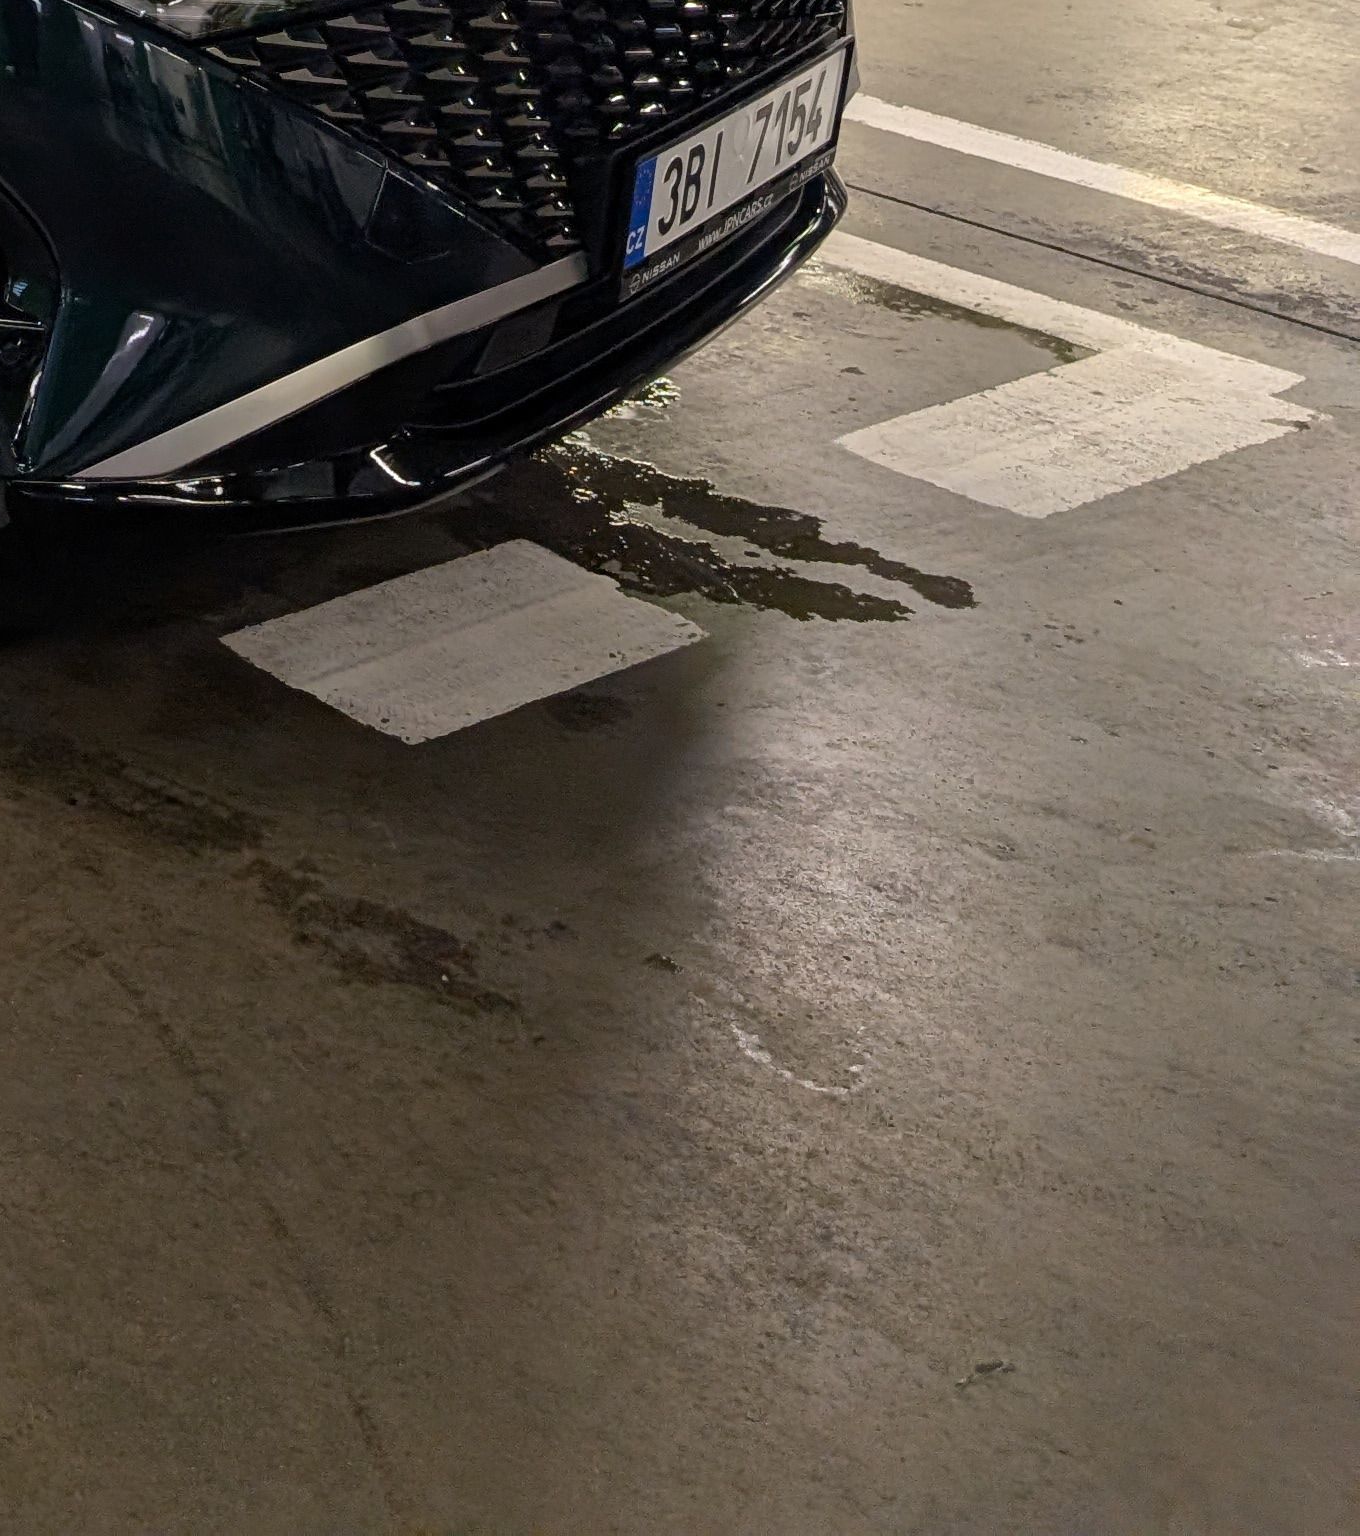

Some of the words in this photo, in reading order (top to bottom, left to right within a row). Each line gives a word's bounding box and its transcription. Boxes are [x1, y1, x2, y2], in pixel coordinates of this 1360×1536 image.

[626, 227, 646, 254] CZ
[658, 131, 724, 236] 3BI
[746, 69, 826, 185] 7154
[799, 157, 831, 183] NISSAN
[641, 251, 681, 282] NISSAN
